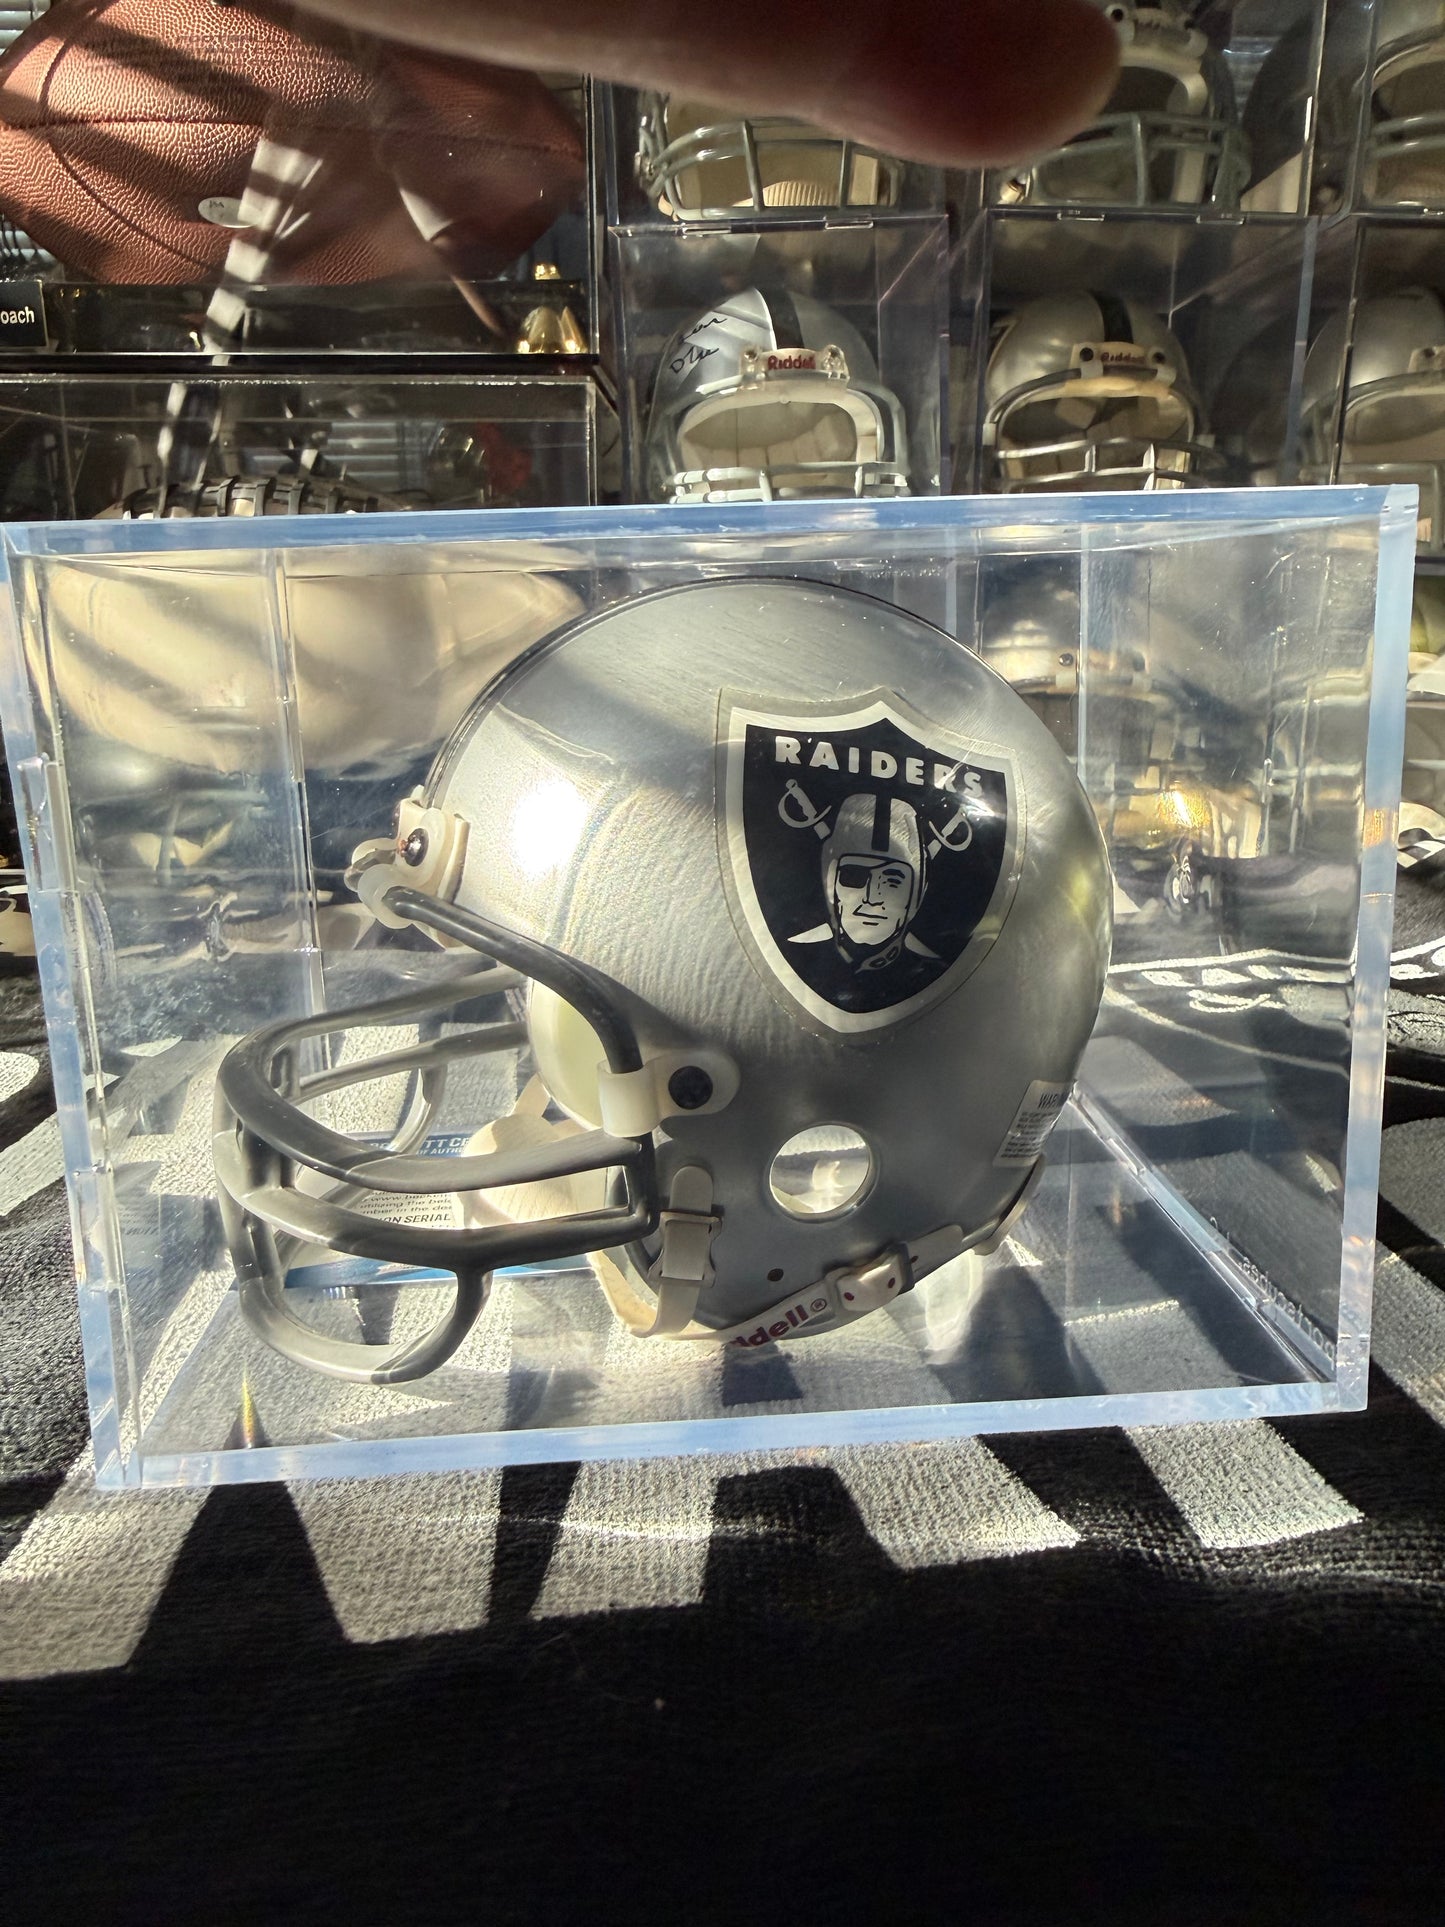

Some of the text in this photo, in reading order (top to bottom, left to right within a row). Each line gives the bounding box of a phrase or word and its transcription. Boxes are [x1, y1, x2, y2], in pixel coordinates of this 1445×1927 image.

[0, 306, 35, 324] oach
[775, 735, 983, 798] RAIDERS
[404, 1213, 452, 1223] SERIAL
